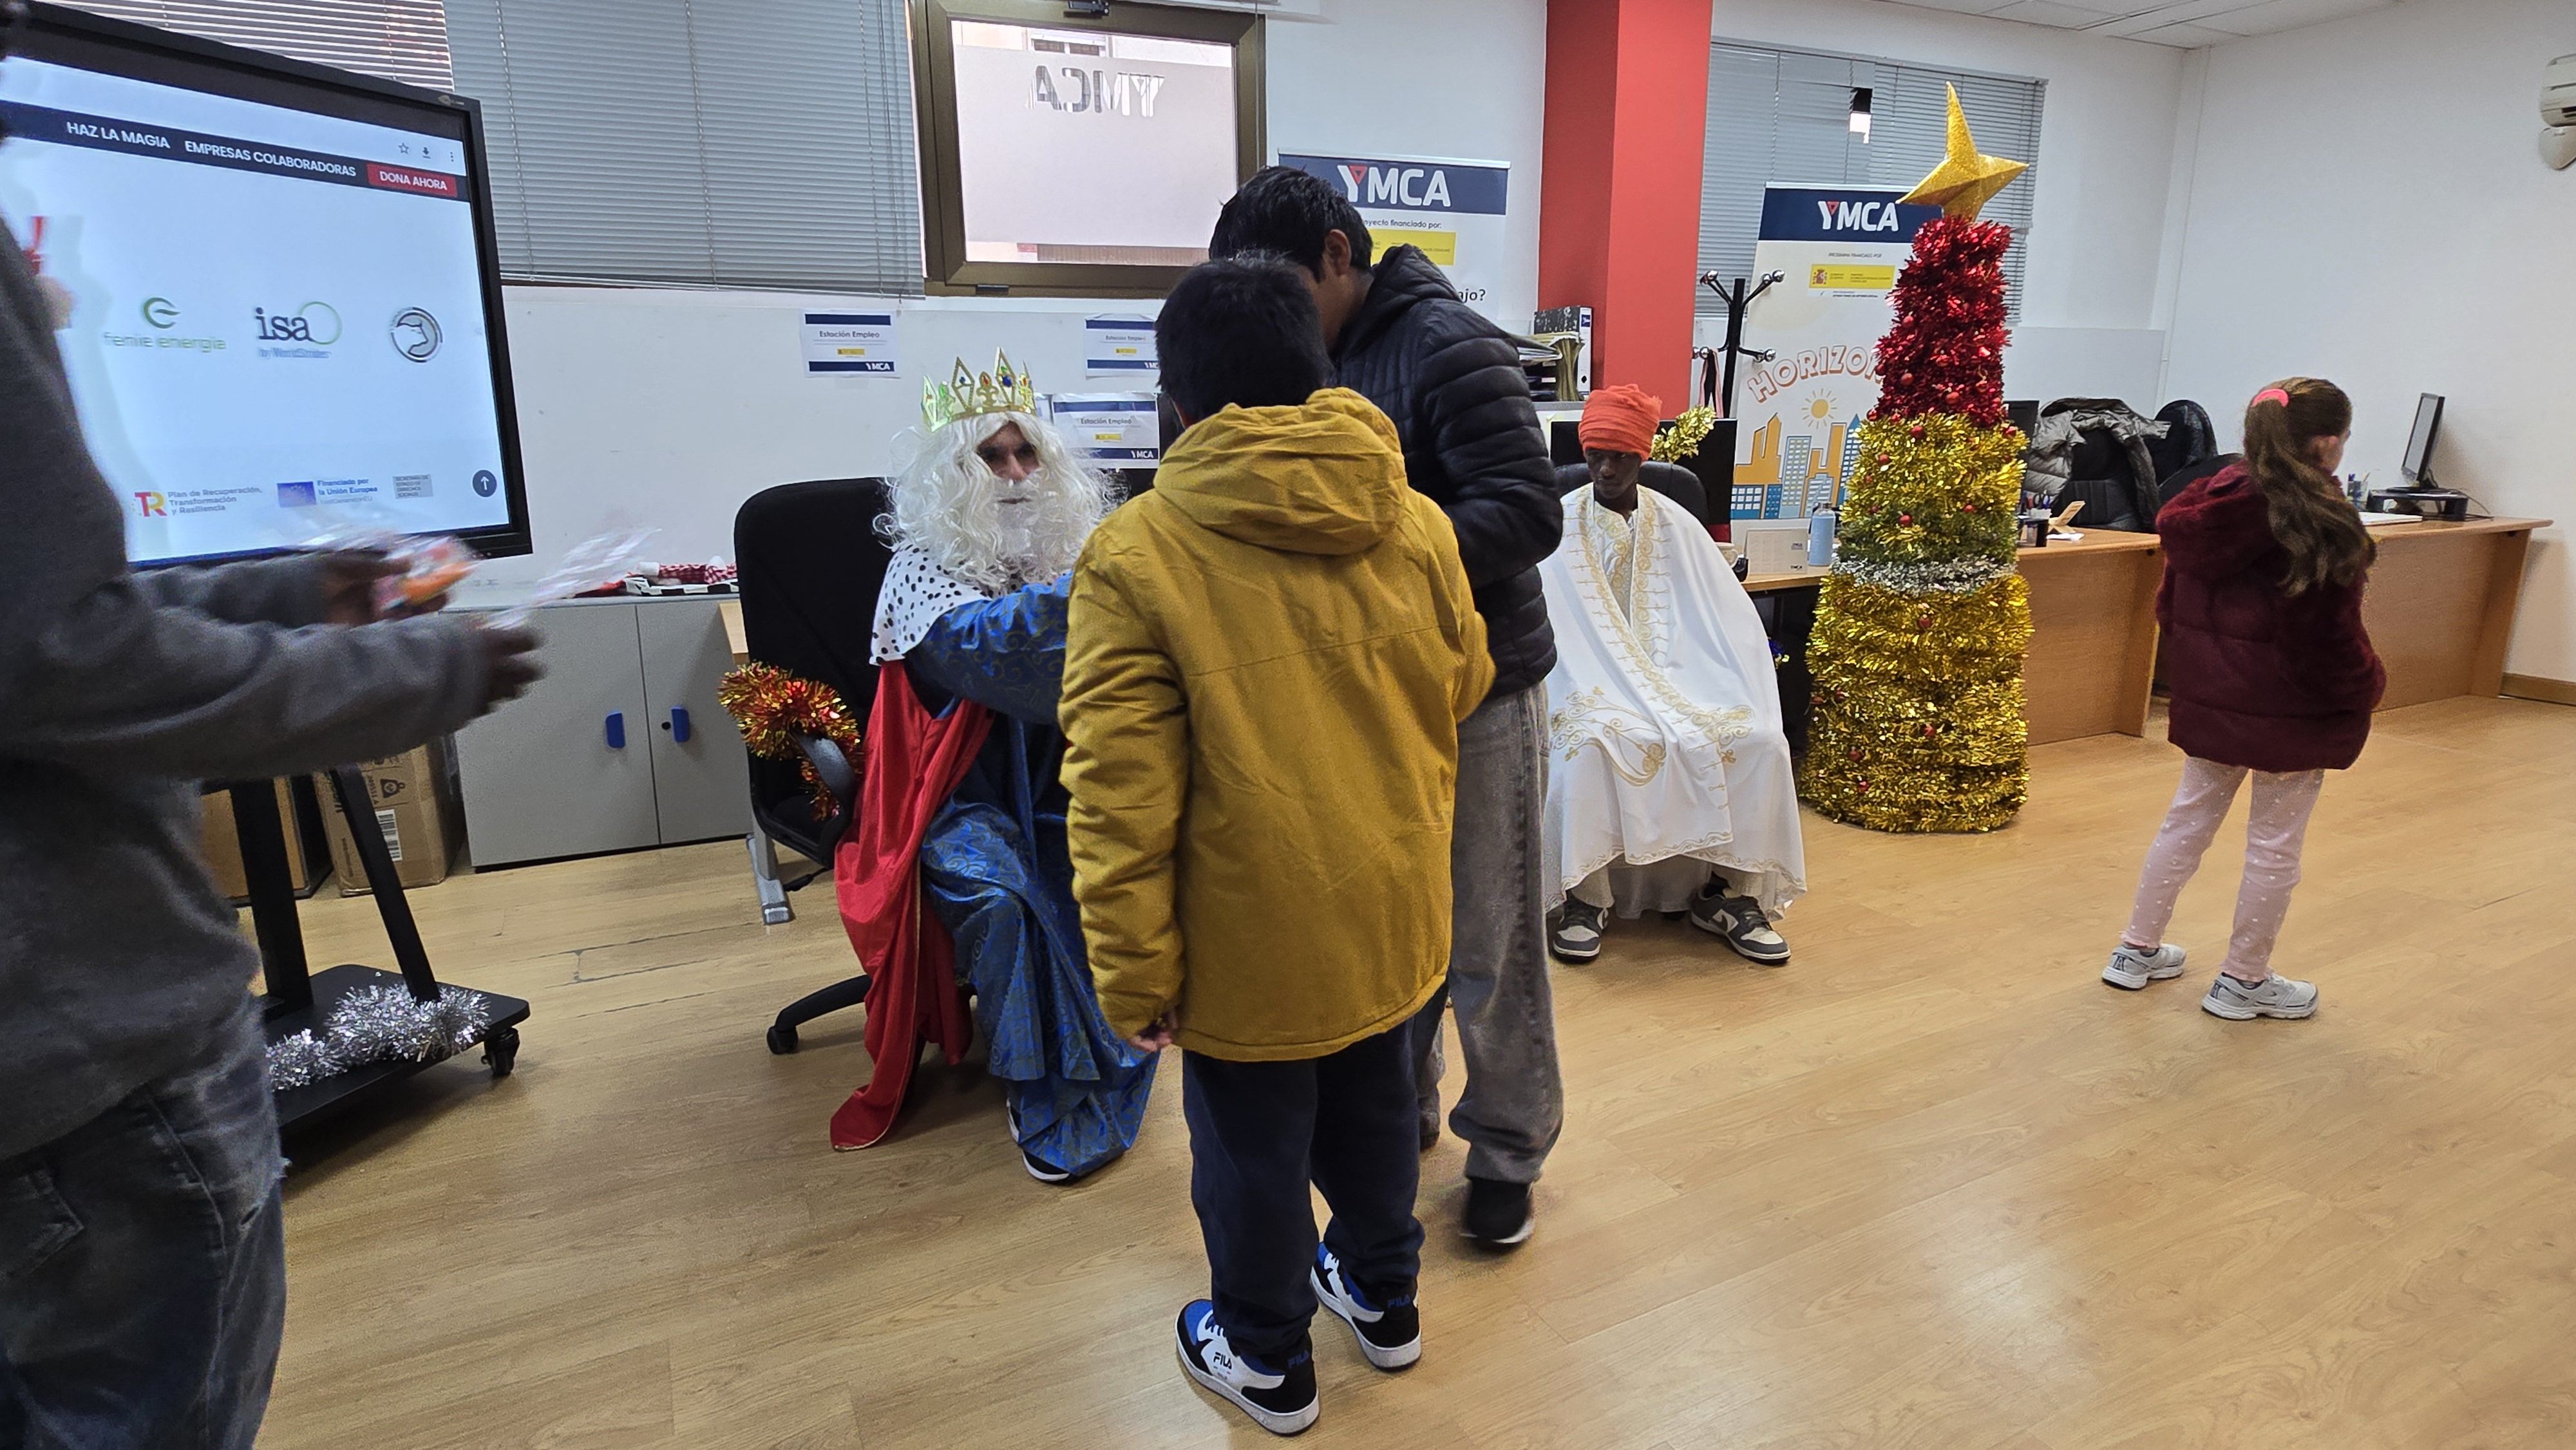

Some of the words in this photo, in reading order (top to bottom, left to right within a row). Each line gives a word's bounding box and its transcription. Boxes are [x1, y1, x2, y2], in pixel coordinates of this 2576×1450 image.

[66, 121, 99, 138] HAZ
[100, 127, 120, 141] LA
[121, 131, 171, 149] MAGIA
[184, 140, 251, 161] EMPRESAS
[252, 151, 357, 176] COLABORADORAS
[379, 171, 410, 185] DONA
[413, 176, 448, 191] AHORA
[1337, 165, 1451, 207] YMCA
[1390, 220, 1426, 228] financiado
[1817, 201, 1899, 232] YMCA
[1458, 289, 1486, 303] ajo?
[255, 306, 314, 342] isa
[317, 478, 355, 487] Financiado
[357, 478, 369, 487] por
[327, 487, 348, 495] Unión
[350, 486, 378, 494] Europea
[169, 496, 237, 506] Transformación
[179, 505, 226, 514] Resiliencia
[1387, 1294, 1411, 1309] FILA
[1213, 1351, 1233, 1370] FILA
[1287, 1350, 1310, 1370] FILA
